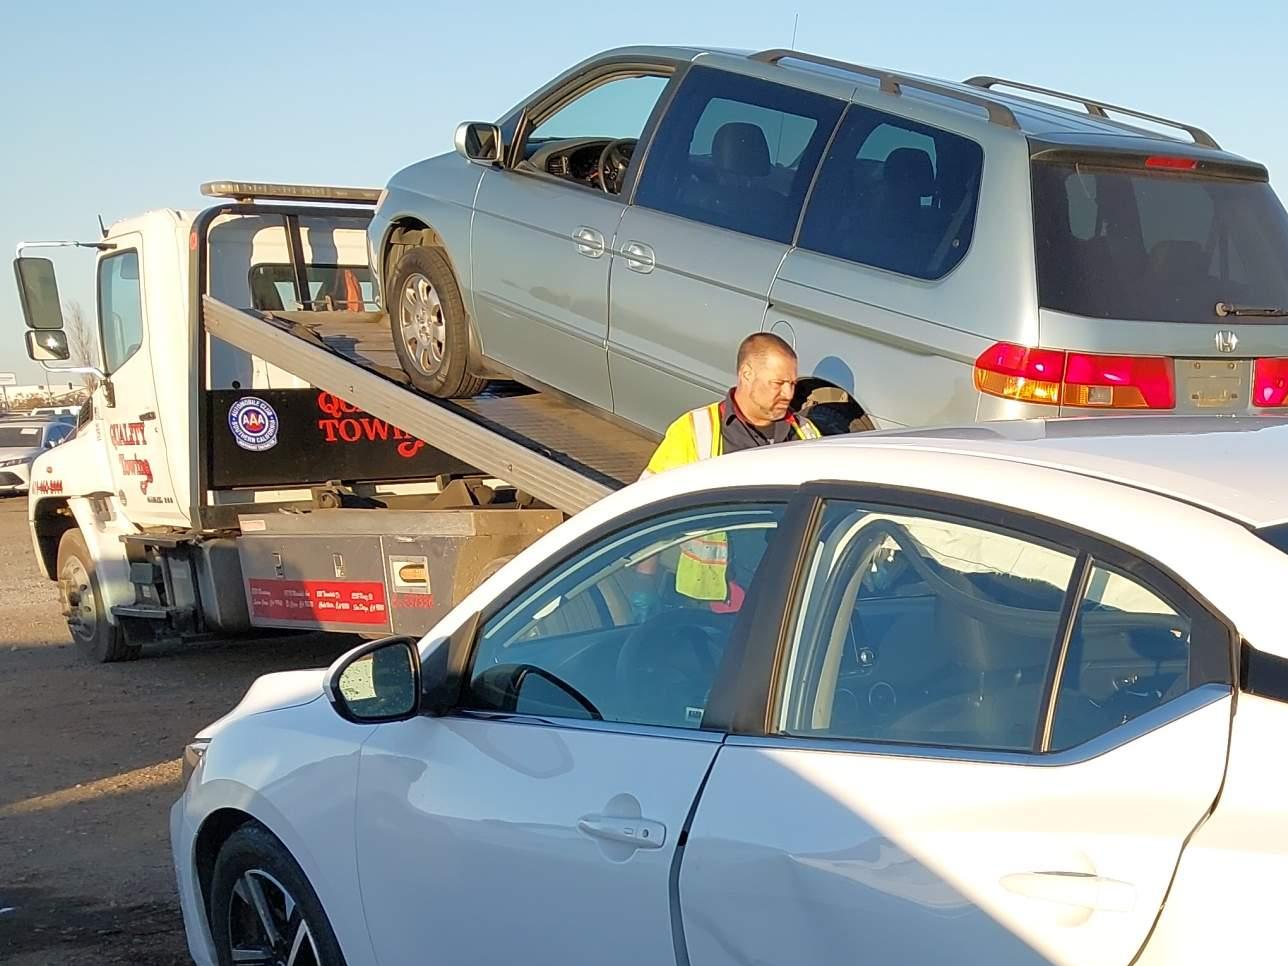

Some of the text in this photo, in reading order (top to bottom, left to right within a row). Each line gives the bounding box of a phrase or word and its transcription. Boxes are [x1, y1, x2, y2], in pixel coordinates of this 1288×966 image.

[231, 400, 273, 417] AUTOMOBILE CLUB
[242, 412, 265, 426] AAA
[110, 422, 147, 450] QUALITY
[231, 420, 276, 443] SOUTHERN CALIFORNIA
